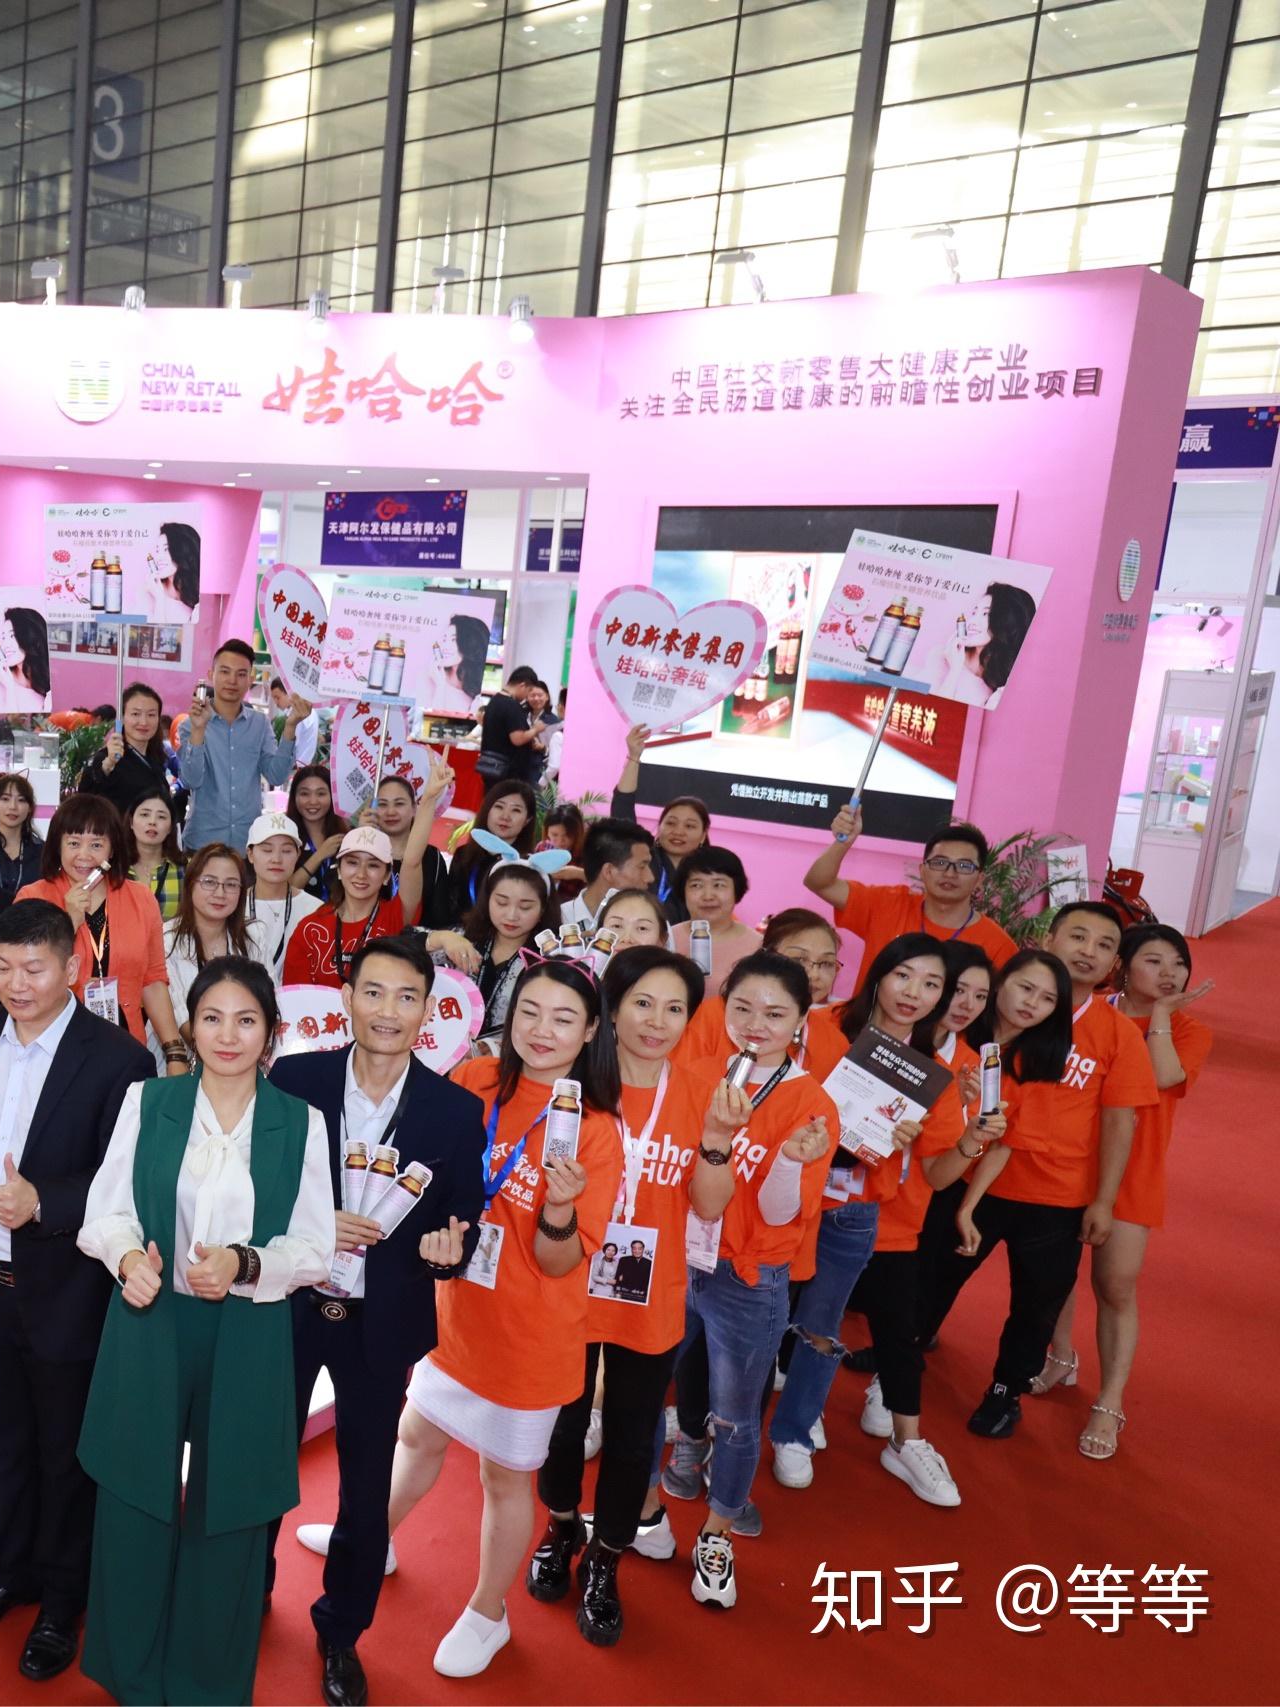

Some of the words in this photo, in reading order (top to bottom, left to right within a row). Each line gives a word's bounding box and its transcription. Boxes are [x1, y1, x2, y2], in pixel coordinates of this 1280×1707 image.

[93, 85, 124, 160] 3
[141, 363, 196, 379] CHINA
[141, 380, 181, 396] NEW
[185, 381, 241, 397] RETAIL
[262, 347, 503, 426] 娃哈哈
[671, 343, 1028, 389] 中国社交新零售大健康产业
[619, 366, 1104, 420] 关注全民肠道健康的前瞻性创业项目
[327, 521, 458, 537] 天津阿尔发保健品有限公司
[605, 617, 745, 669] 中国新零售集团
[615, 655, 709, 691] 娃哈哈奢纯
